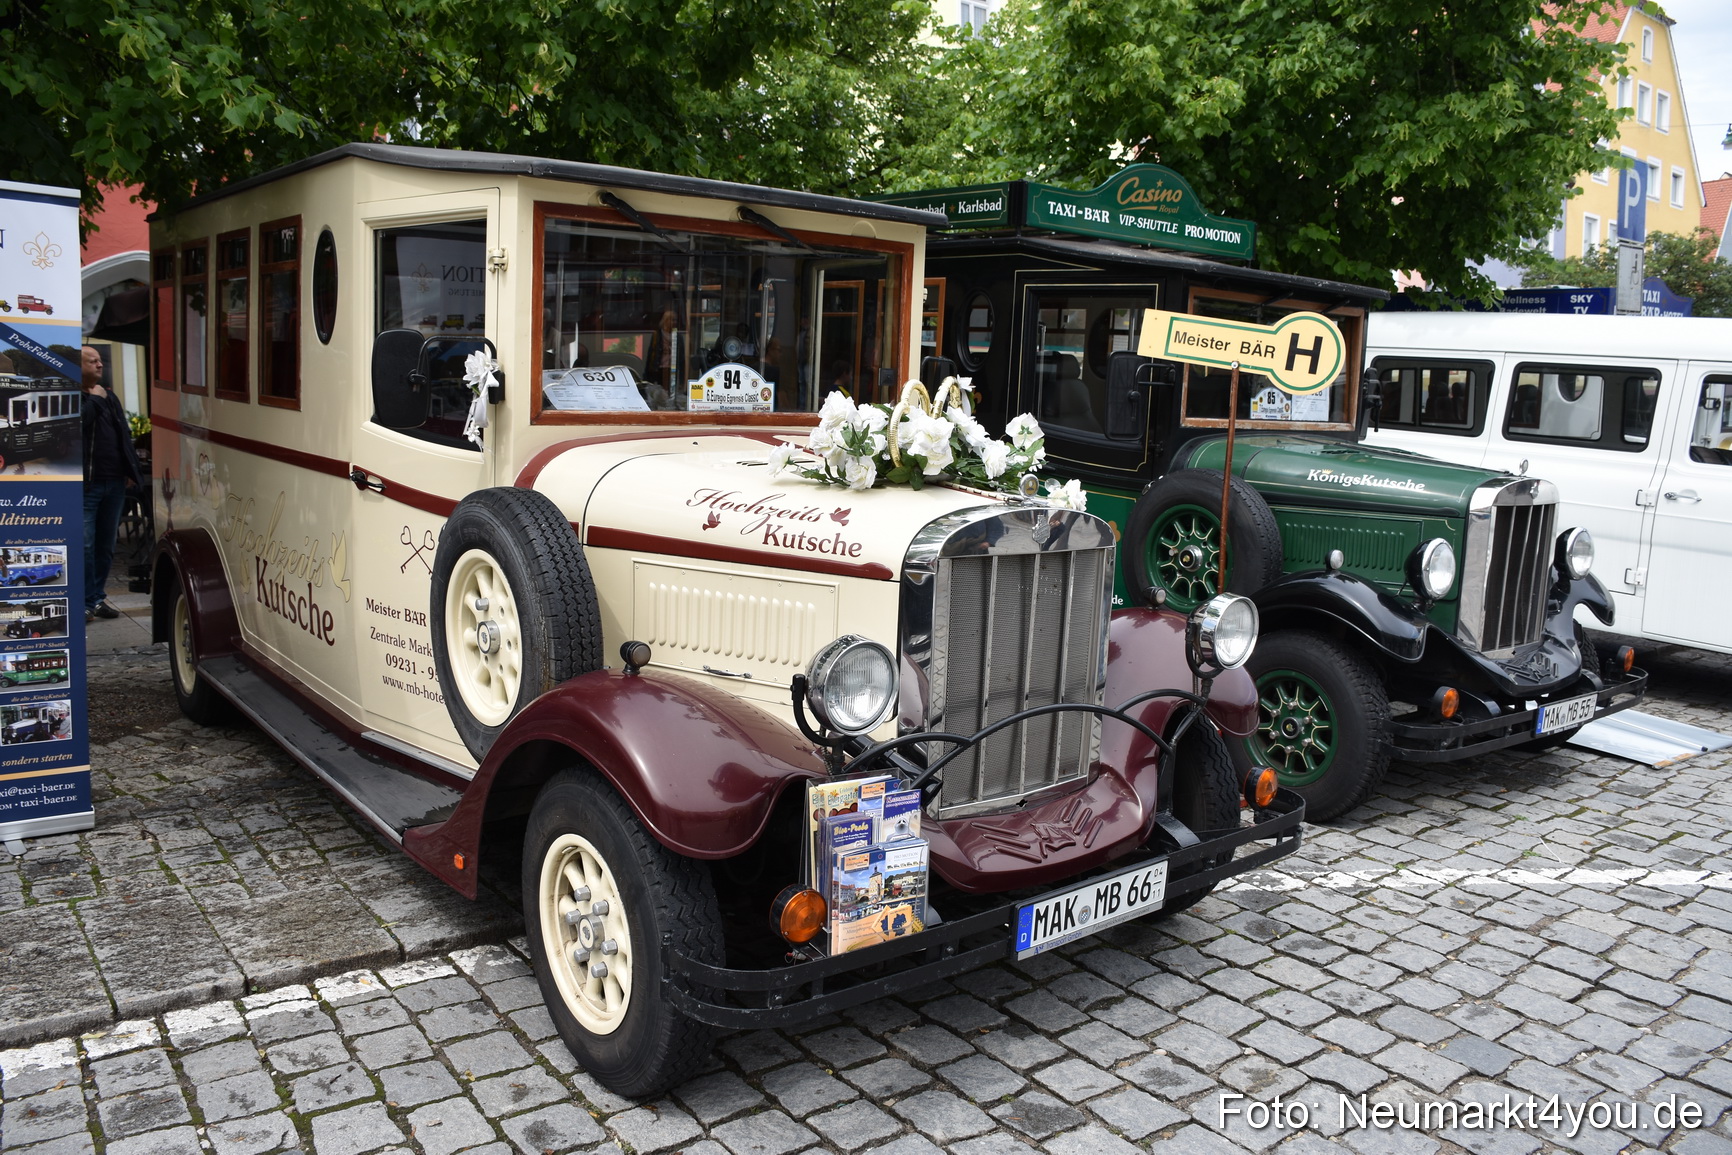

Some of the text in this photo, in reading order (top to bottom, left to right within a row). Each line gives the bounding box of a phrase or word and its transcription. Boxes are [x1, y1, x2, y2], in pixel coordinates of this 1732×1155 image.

[1116, 176, 1183, 205] Casino
[1623, 168, 1641, 229] P
[957, 197, 1002, 214] Karlsbad
[1158, 204, 1180, 215] Royal
[1118, 213, 1178, 234] VIP-SHUTTLE
[1501, 295, 1546, 305] Wellness
[1570, 294, 1593, 304] SKY
[1642, 289, 1661, 304] TAXI
[1573, 306, 1589, 315] TV
[8, 333, 64, 368] ProbeFahrten
[1173, 330, 1276, 359] Meister BÄR
[1284, 332, 1324, 375] H
[583, 371, 616, 382] 630
[723, 370, 741, 390] 94
[1267, 391, 1276, 405] 85
[16, 495, 48, 507] Altes
[0, 512, 63, 526] ldtimern
[686, 488, 825, 536] Hochzeits
[222, 490, 325, 612] Hochzeits
[762, 523, 863, 558] Kutsche
[255, 555, 335, 647] Kutsche
[366, 597, 427, 627] Meister BÄR
[370, 626, 433, 658] Zentrale Mark
[386, 653, 417, 675] 09231
[382, 675, 446, 705] www.mb-hote
[1579, 698, 1592, 719] 55
[1, 753, 73, 767] sondern starten
[1033, 871, 1152, 942] MAK MB 66
[1020, 932, 1027, 943] D
